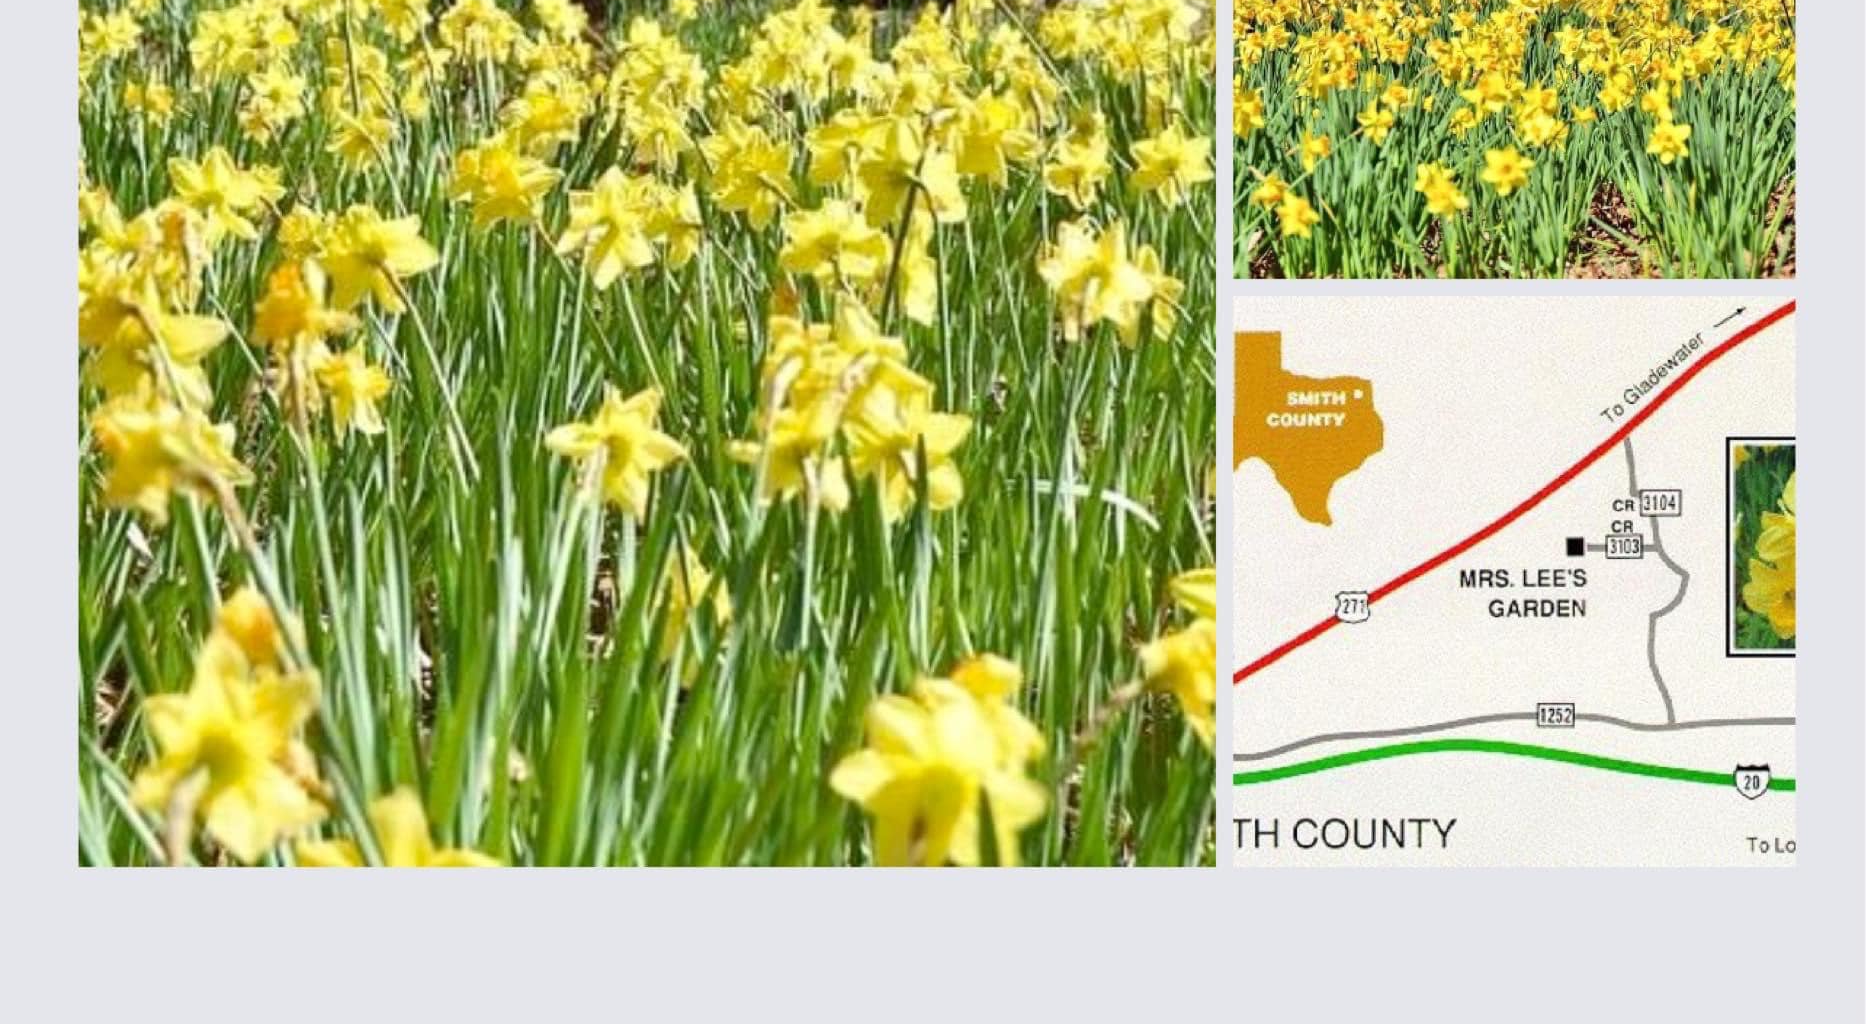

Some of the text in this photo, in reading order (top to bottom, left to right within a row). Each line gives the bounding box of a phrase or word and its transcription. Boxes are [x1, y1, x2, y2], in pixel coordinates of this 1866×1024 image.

[1600, 332, 1704, 423] To Gladewater
[1287, 391, 1346, 406] SMITH
[1266, 412, 1345, 427] COUNTY
[1612, 495, 1676, 512] CR 3104
[1611, 520, 1634, 533] CR
[1610, 539, 1640, 554] 3103
[1459, 568, 1587, 588] MRS. LEE'S
[1342, 598, 1364, 614] 271
[1488, 599, 1586, 618] GARDEN
[1541, 707, 1572, 724] 1252
[1744, 775, 1760, 790] 20
[1233, 818, 1457, 849] TH COUNTY
[1745, 837, 1796, 853] To Lo
